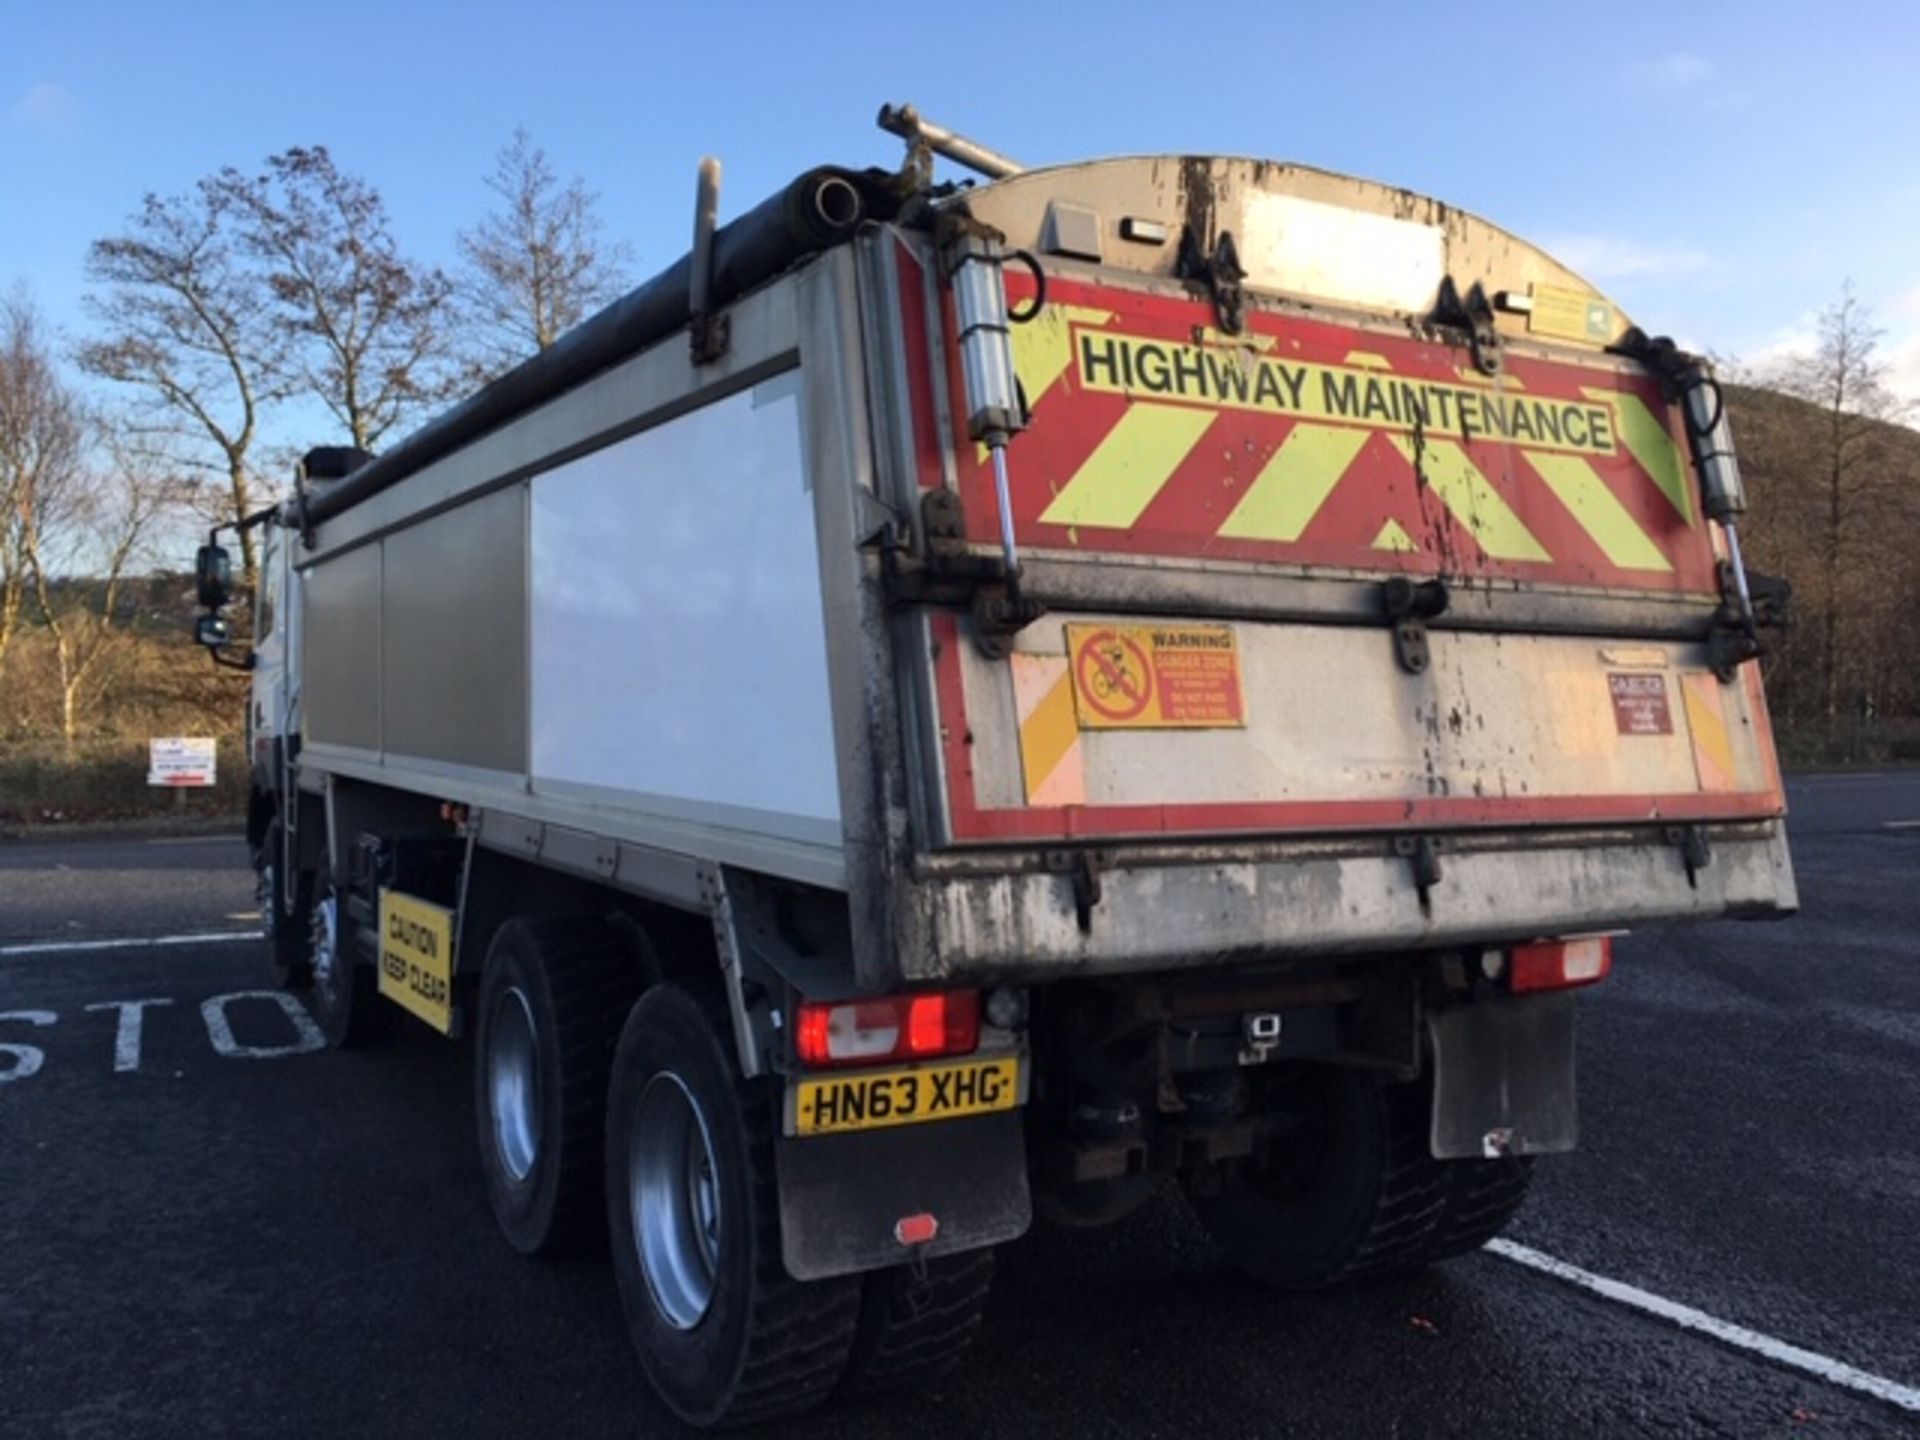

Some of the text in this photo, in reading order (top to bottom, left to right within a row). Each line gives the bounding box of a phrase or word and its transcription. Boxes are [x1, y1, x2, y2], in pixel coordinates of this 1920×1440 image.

[1080, 335, 1613, 450] HIGHWAY MAINTENANCE
[1151, 633, 1231, 648] WARNING
[389, 912, 437, 958] CAUTION
[384, 950, 450, 1006] KEEP CLEAR
[813, 1067, 1000, 1126] HN63 XHG
